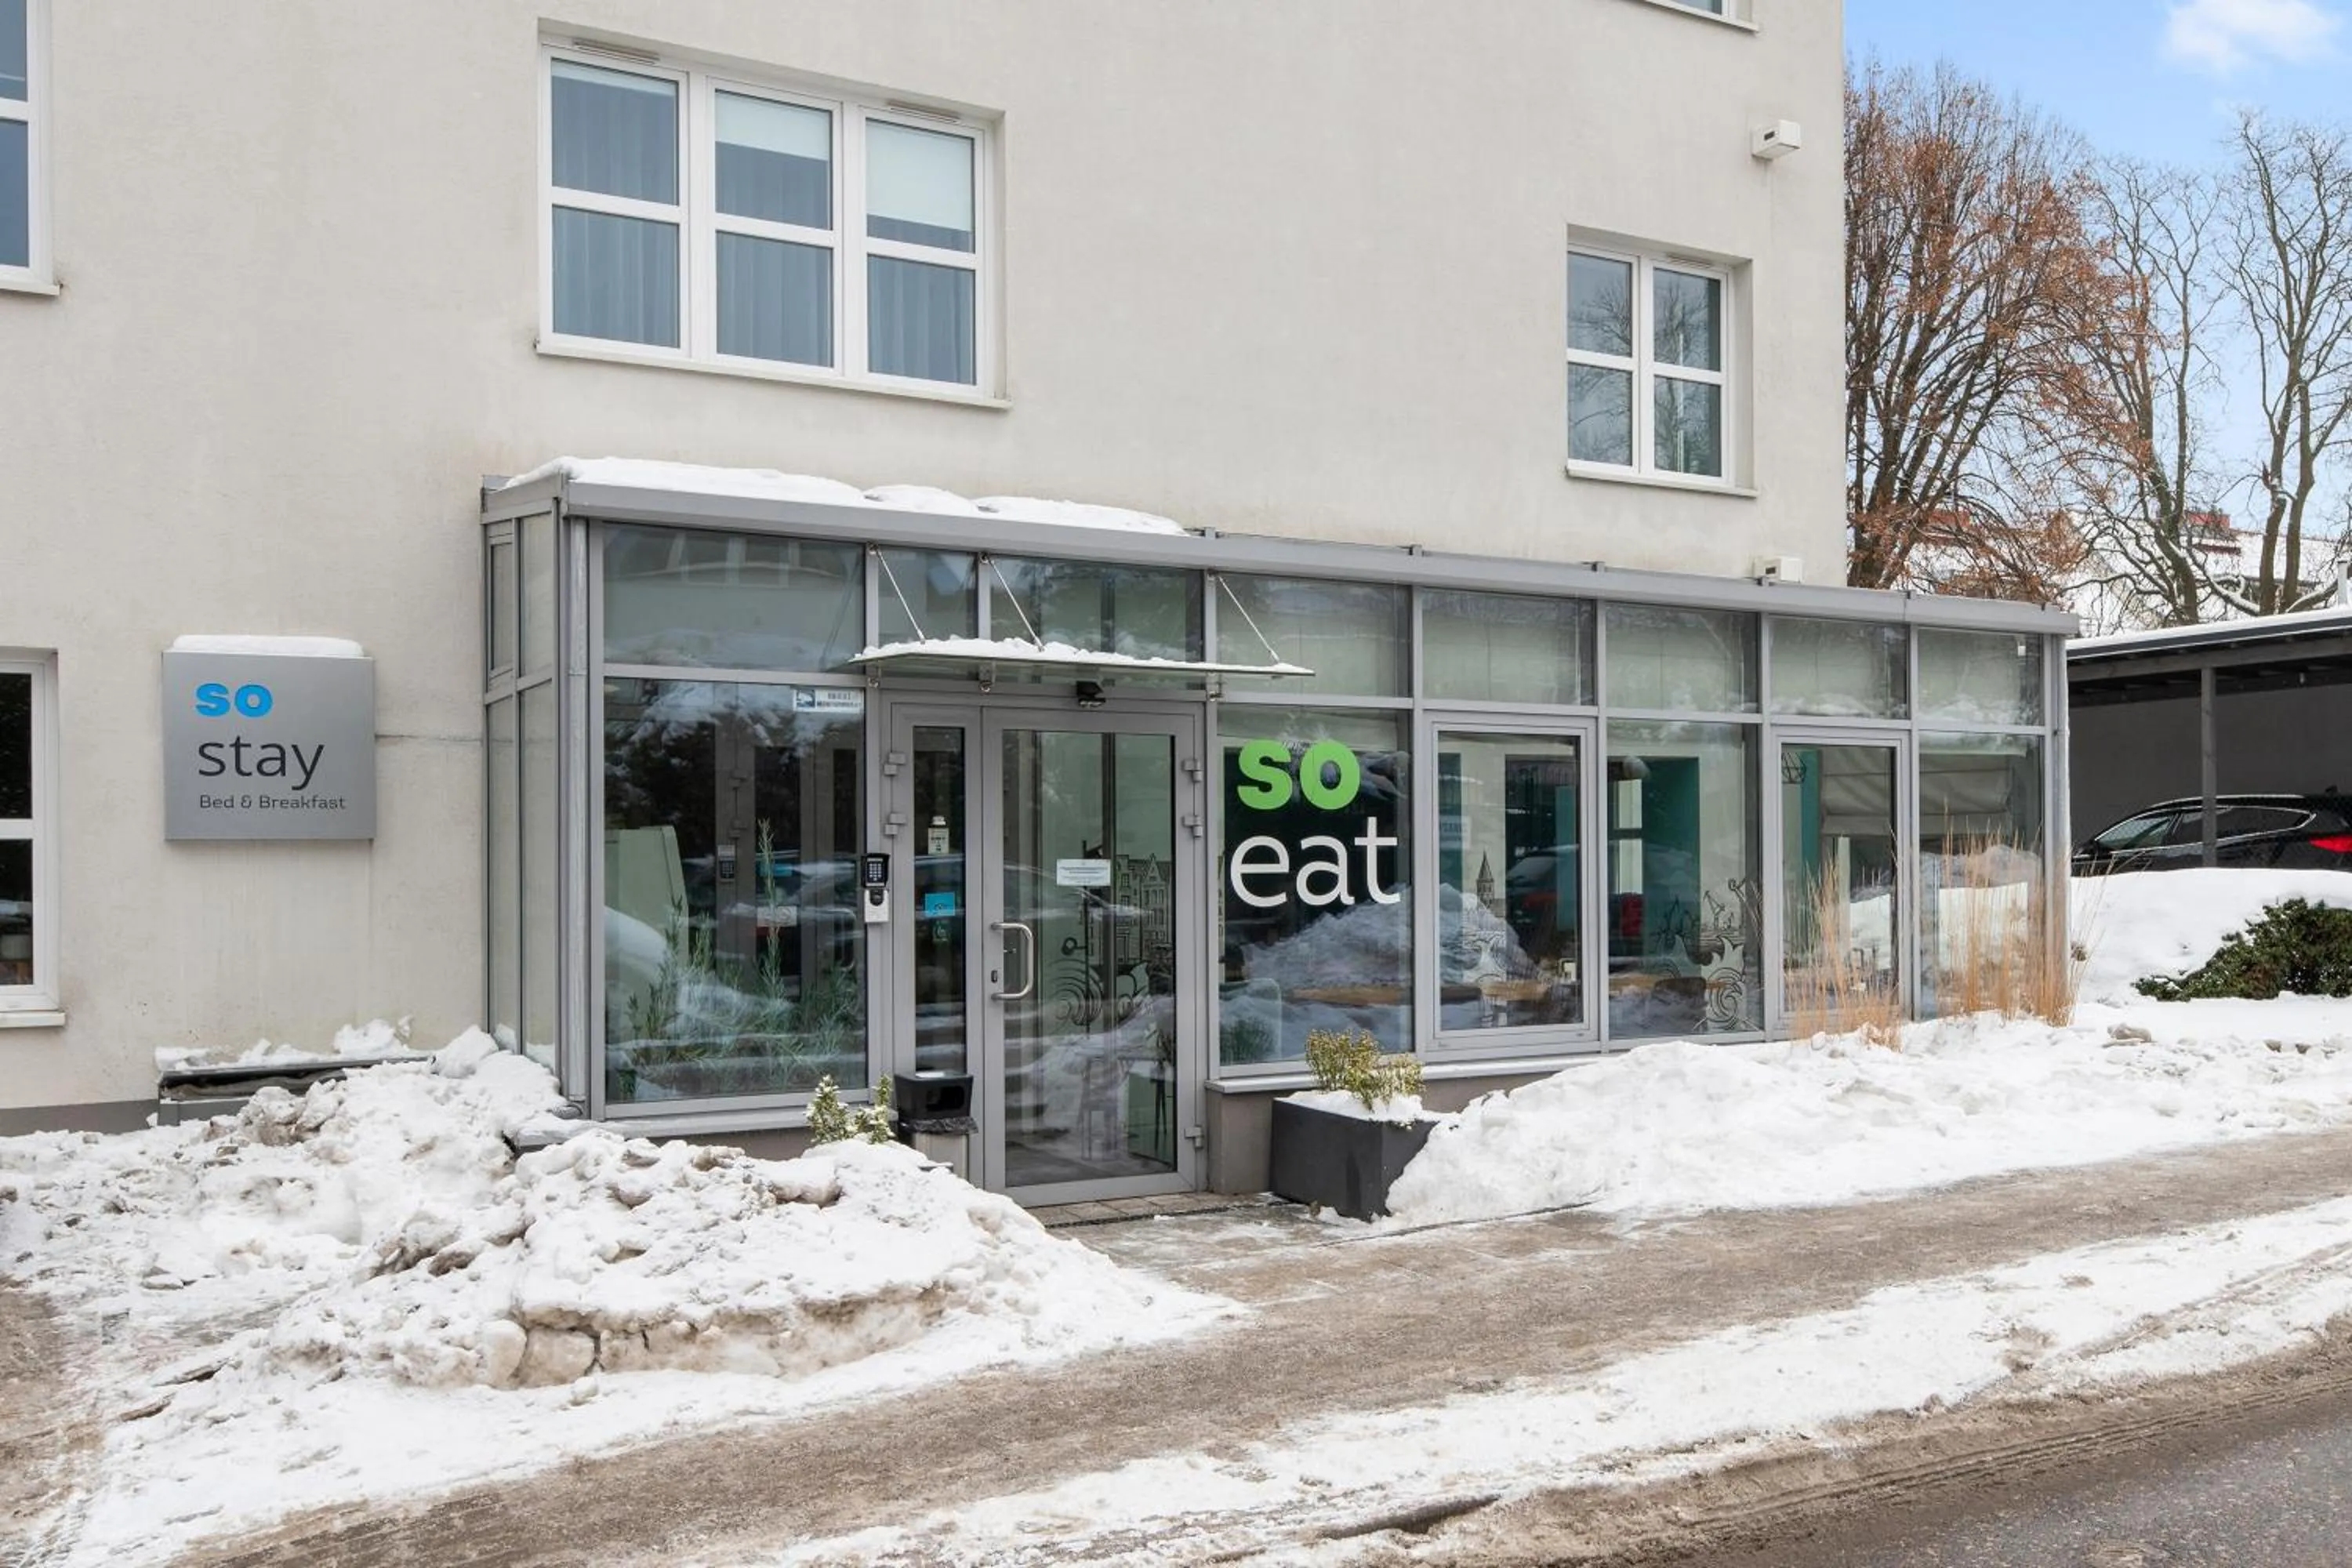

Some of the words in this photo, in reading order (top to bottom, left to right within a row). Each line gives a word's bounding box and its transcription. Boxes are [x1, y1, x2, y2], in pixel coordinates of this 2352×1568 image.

[195, 683, 273, 717] so
[198, 735, 325, 791] stay
[1237, 738, 1360, 810] so
[200, 795, 234, 809] Bed
[241, 795, 252, 809] &
[260, 796, 346, 810] Breakfast
[1230, 816, 1401, 907] eat
